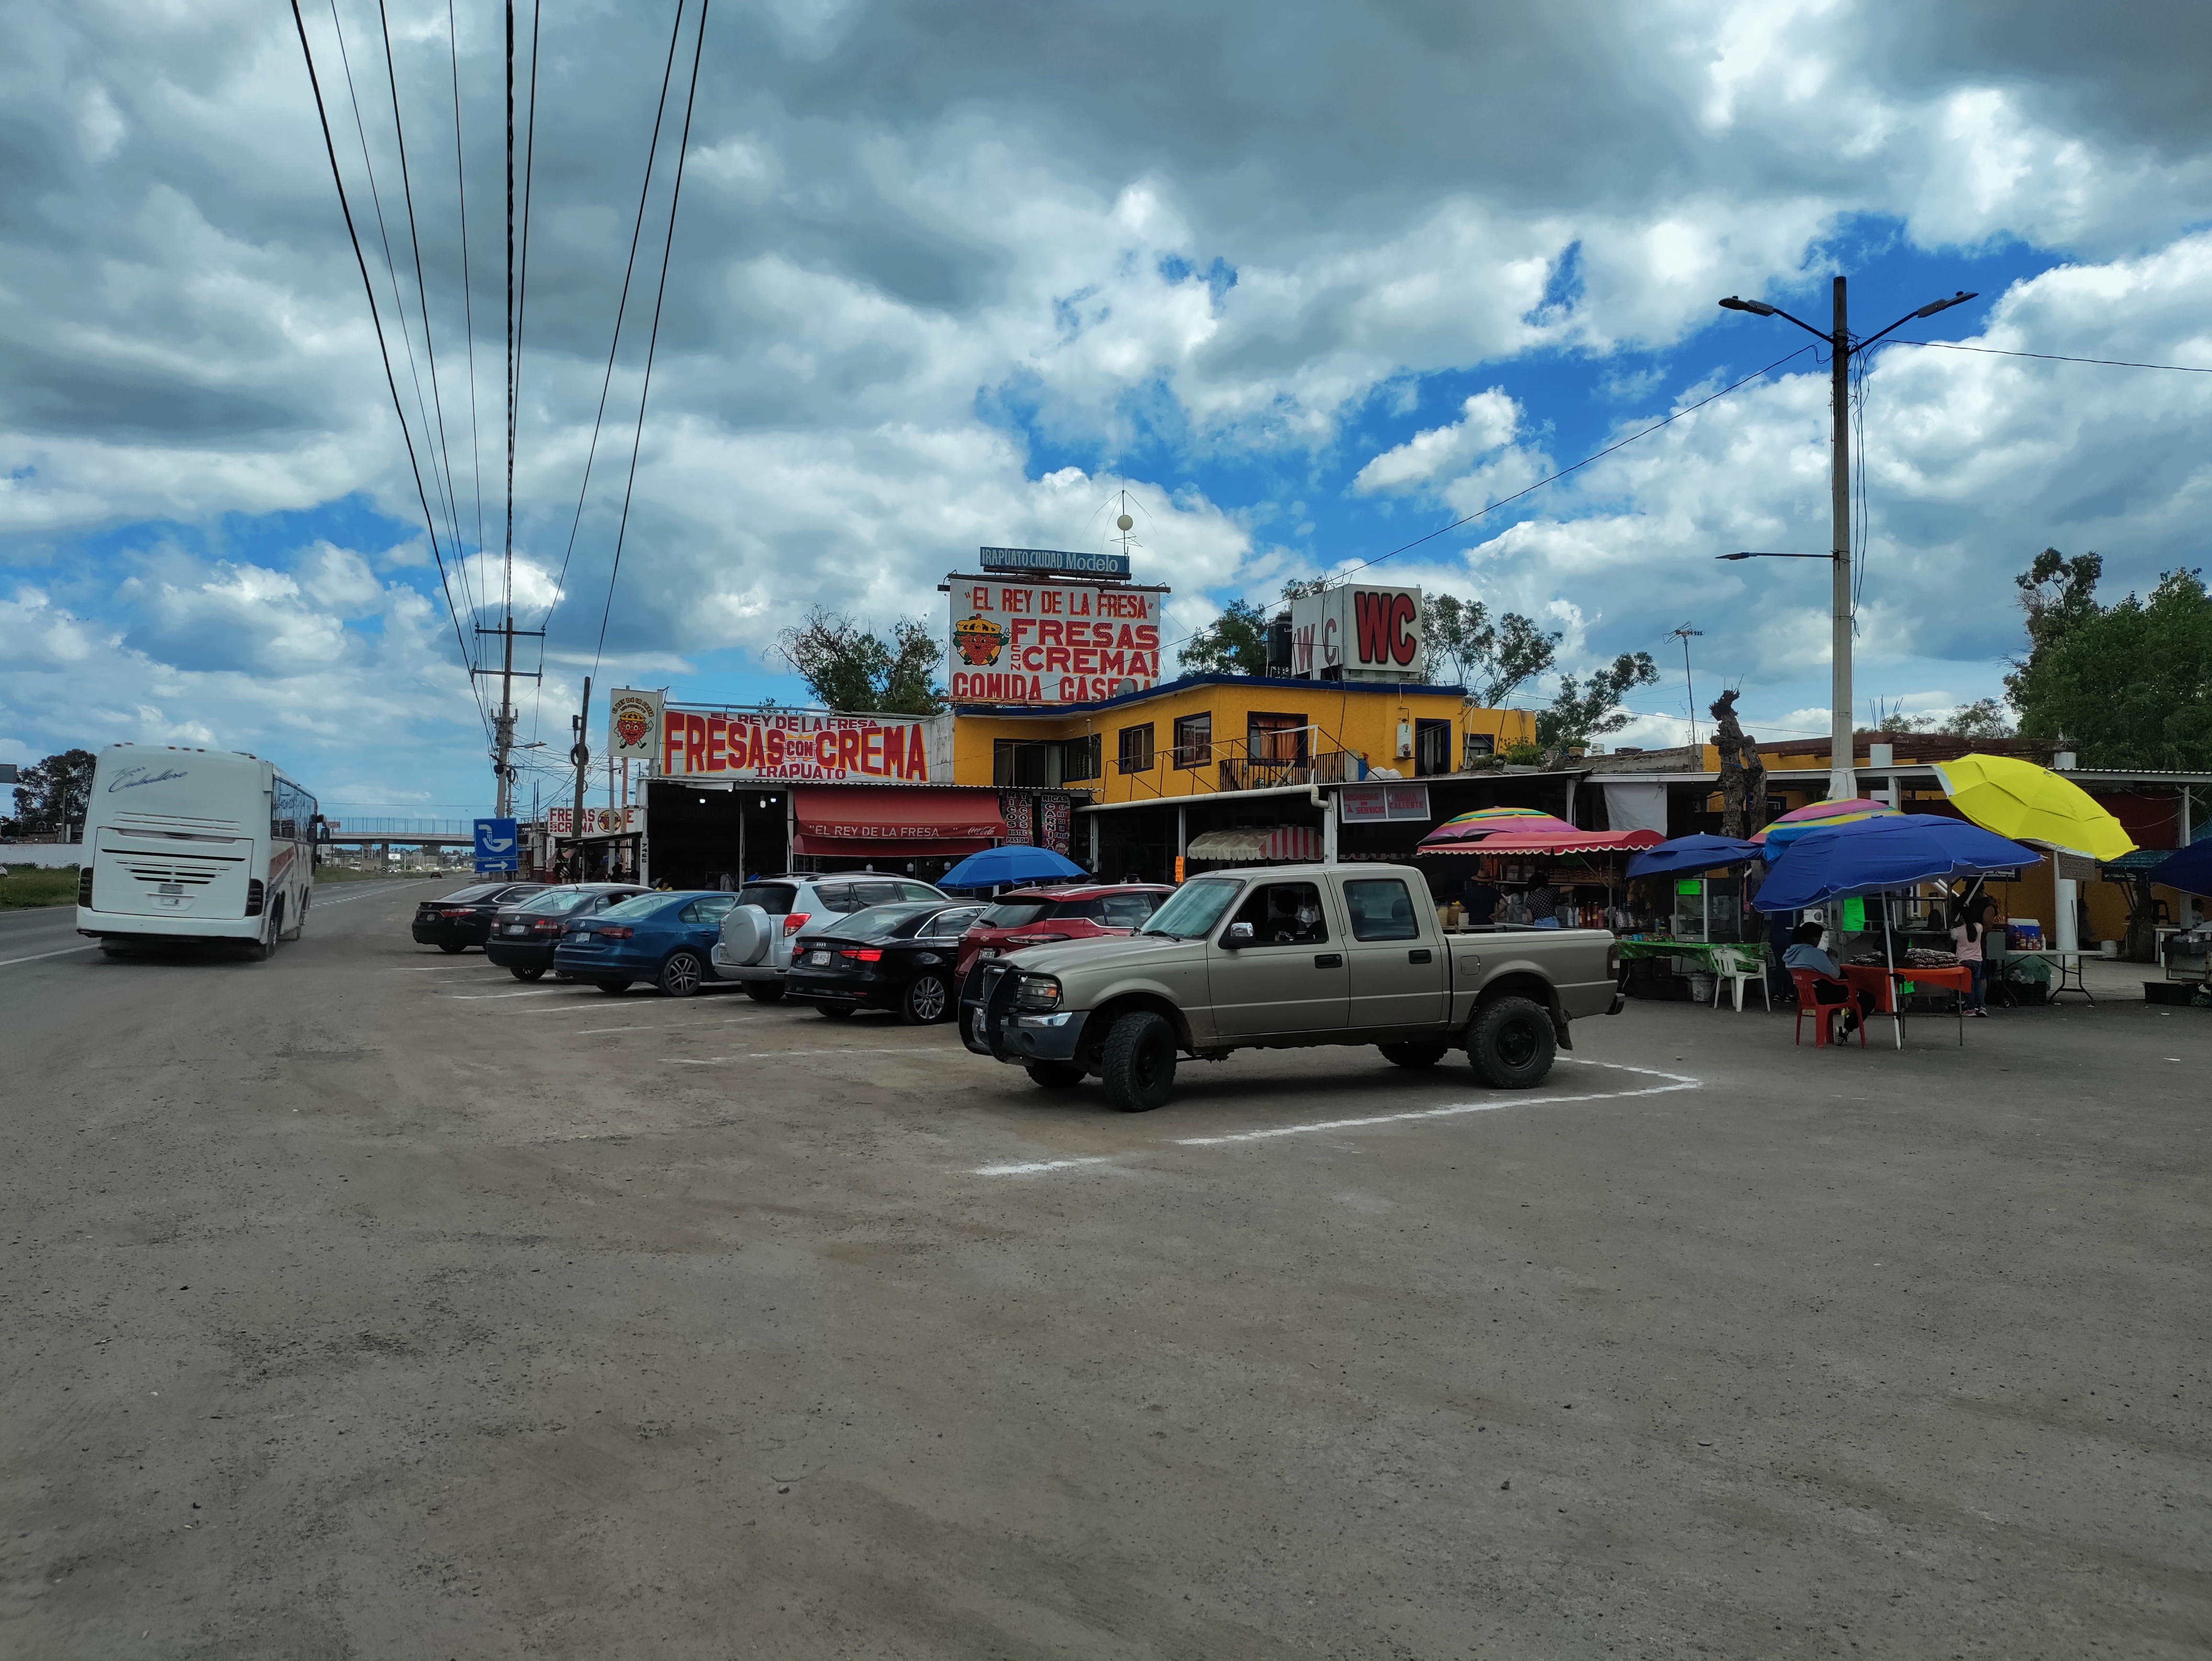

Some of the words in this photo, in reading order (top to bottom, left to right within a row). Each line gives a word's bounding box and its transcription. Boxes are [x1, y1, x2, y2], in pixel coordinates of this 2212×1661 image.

[982, 549, 1029, 566] IRAPUATO
[1030, 551, 1063, 567] CIUDAD
[1066, 553, 1118, 573] Modelo
[1002, 588, 1033, 614] REY
[1041, 590, 1062, 615] DE
[1069, 592, 1091, 617] LA
[1010, 618, 1160, 650] FRESAS
[1354, 591, 1417, 666] WC
[1010, 644, 1021, 671] CON
[1022, 646, 1160, 678] CREMA!
[953, 672, 1042, 700] COMIDA
[615, 699, 625, 709] REY
[710, 713, 735, 721] EL
[738, 714, 770, 727] REY
[775, 716, 799, 732] DE
[802, 718, 823, 733] LA
[827, 718, 878, 730] FRESA
[664, 711, 786, 776] FRESAS
[786, 740, 813, 757] CON
[815, 724, 928, 782] CREMA
[755, 763, 846, 780] IRAPUATO
[1042, 795, 1069, 803] RICAS
[1389, 801, 1424, 809] CALIENTE
[1394, 792, 1418, 802] AGUA
[550, 808, 595, 822] FREAS
[1006, 791, 1017, 828] RICOS
[1019, 792, 1028, 829] TACOS
[557, 822, 595, 833] CRMA
[834, 826, 859, 836] REY
[862, 827, 878, 837] DE
[882, 827, 897, 837] LA
[900, 828, 940, 837] FRESA
